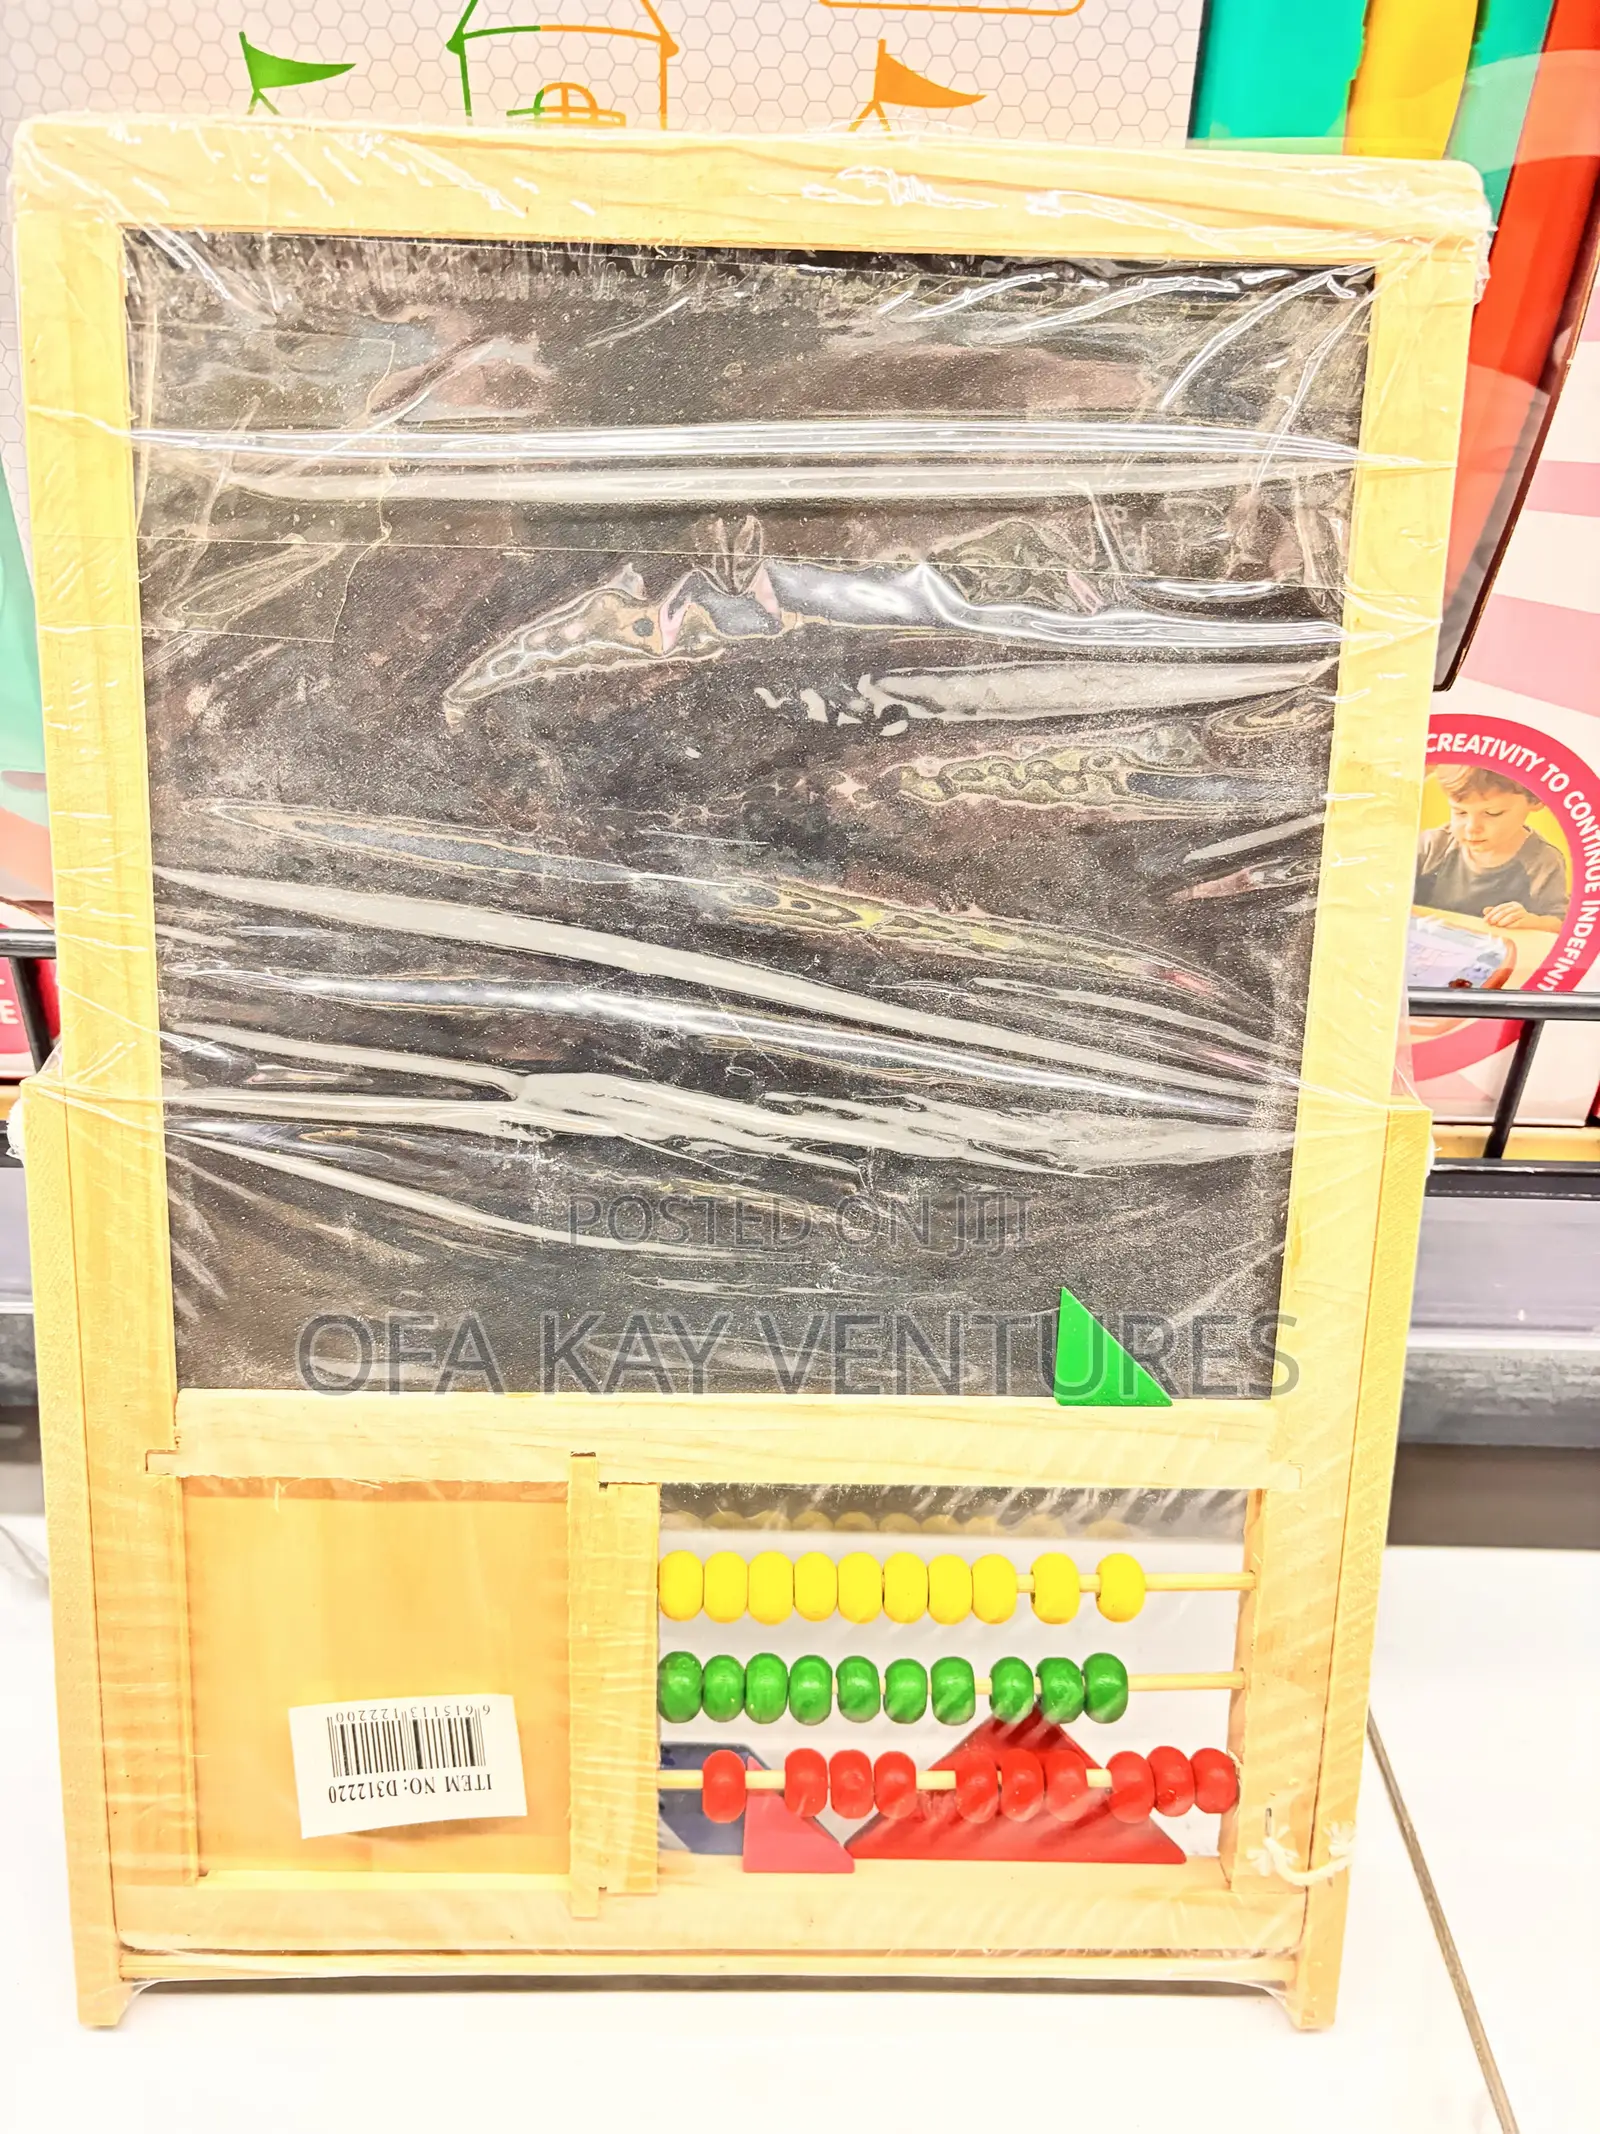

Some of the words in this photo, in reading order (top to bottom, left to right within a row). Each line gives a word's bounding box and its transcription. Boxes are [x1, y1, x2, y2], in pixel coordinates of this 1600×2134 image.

[1426, 733, 1545, 772] CREATIVITY
[1540, 763, 1570, 793] TO
[1563, 790, 1600, 894] CONTINUE
[328, 1779, 398, 1804] D312220
[403, 1776, 436, 1795] NO:
[445, 1774, 493, 1793] ITEM
